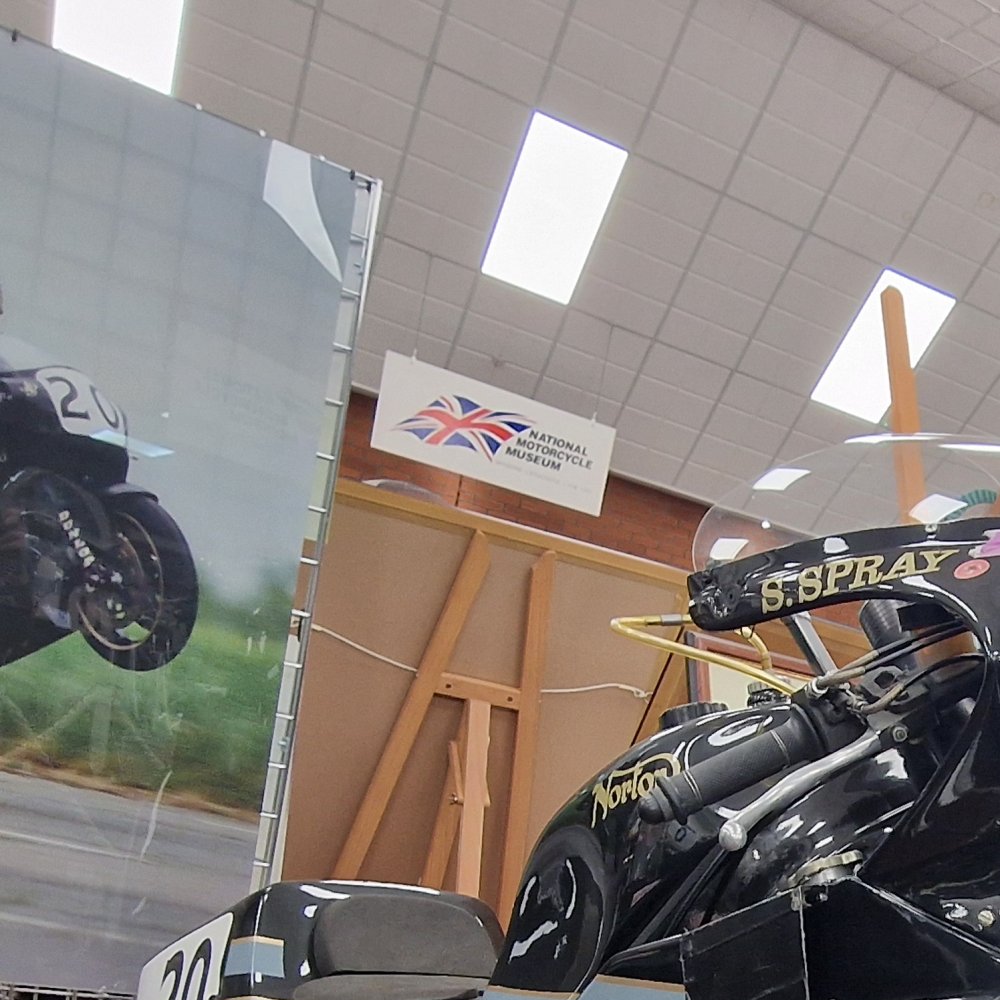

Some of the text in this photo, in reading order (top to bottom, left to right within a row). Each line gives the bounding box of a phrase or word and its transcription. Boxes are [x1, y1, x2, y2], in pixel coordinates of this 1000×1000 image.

[516, 437, 593, 470] MOTORCYCLE
[529, 429, 588, 457] NATIONAL
[505, 446, 562, 472] MUSEUM
